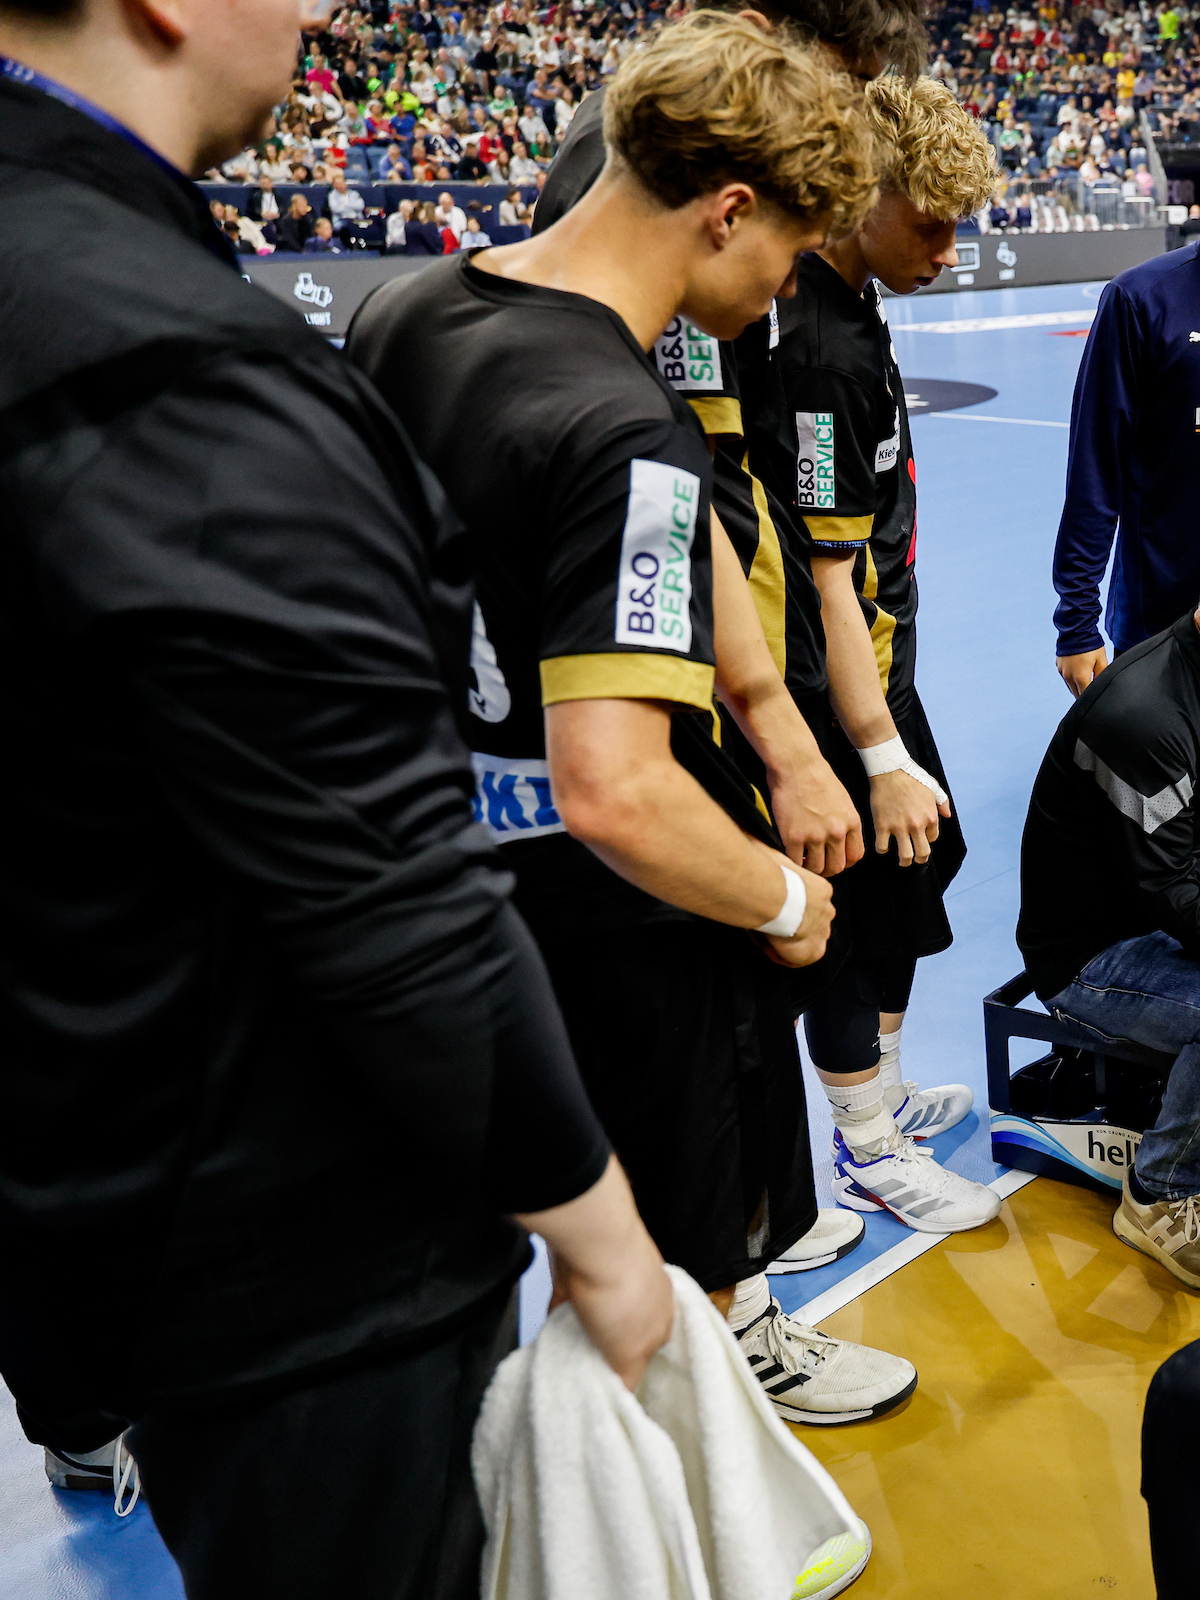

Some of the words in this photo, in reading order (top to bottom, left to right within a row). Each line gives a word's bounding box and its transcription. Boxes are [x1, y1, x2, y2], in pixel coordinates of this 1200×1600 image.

[798, 457, 815, 506] B&O
[815, 413, 834, 508] SERVICE
[628, 551, 660, 634] B&O
[659, 478, 694, 640] SERVICE
[795, 1556, 834, 1586] empa
